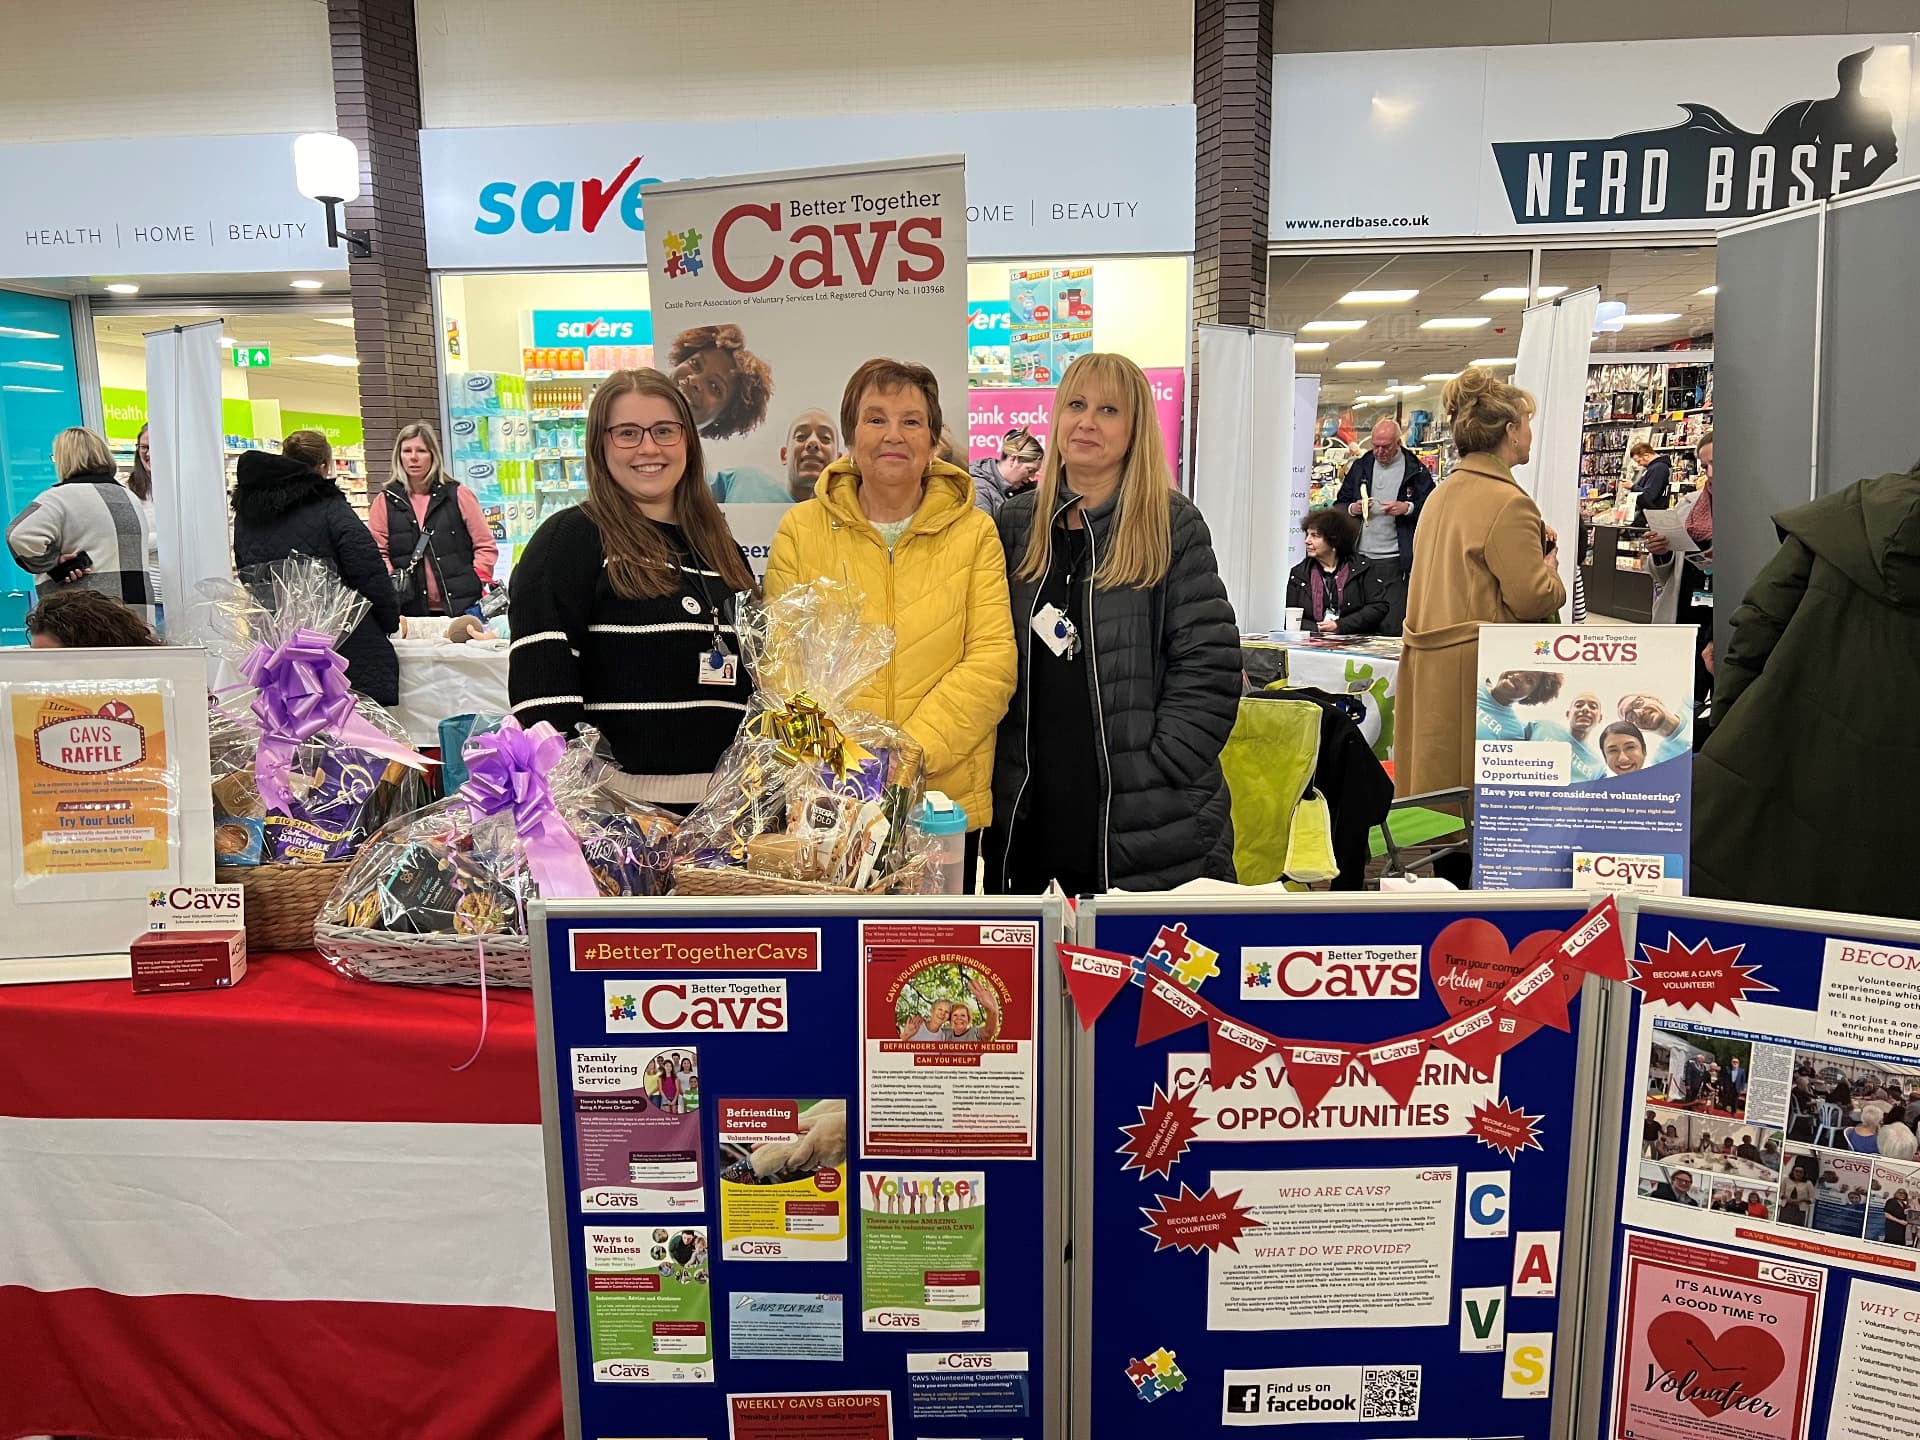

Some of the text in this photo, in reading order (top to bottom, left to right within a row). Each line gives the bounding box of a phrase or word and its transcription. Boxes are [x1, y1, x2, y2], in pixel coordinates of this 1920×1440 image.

[1525, 142, 1853, 218] NERD BASE
[474, 155, 668, 235] save
[789, 190, 942, 218] Better Together
[966, 202, 1139, 222] OME BEAUTY
[1285, 214, 1430, 231] www.nerdbase.co.uk
[25, 223, 307, 246] HEALTH HOME BEAUTY
[711, 202, 945, 294] Cavs
[703, 296, 742, 307] Association
[743, 295, 751, 305] of
[751, 293, 785, 307] Voluntary
[785, 293, 815, 303] Services
[830, 289, 867, 301] Registered
[868, 288, 895, 300] Charity
[897, 286, 912, 296] No.
[912, 285, 945, 295] 1103968
[556, 317, 633, 339] savers
[104, 403, 143, 420] Health
[968, 404, 1048, 427] pink sack
[1605, 634, 1637, 643] Together
[1553, 634, 1637, 662] Cavs
[70, 726, 112, 744] CAVS
[61, 745, 122, 764] RAFFLE
[1482, 744, 1513, 753] CAVS
[1482, 757, 1554, 769] Volunteering
[1482, 770, 1559, 782] Opportunities
[1480, 787, 1681, 804] Have you ever considered volunteering?
[59, 814, 135, 828] Try Your Luck!
[279, 833, 308, 847] DAIRY
[307, 840, 330, 852] MILK
[1594, 856, 1661, 880] Cavs
[169, 887, 241, 910] Cavs
[991, 928, 1032, 943] Cavs
[1571, 917, 1608, 949] Cavs
[584, 943, 808, 964] #BetterTogetherCavs
[1327, 950, 1417, 962] Better Together
[1445, 954, 1491, 971] Turn your
[1840, 947, 1920, 972] BECOM
[1082, 958, 1120, 977] Cavs
[1277, 951, 1418, 998] Cavs
[1652, 969, 1723, 979] BECOME A CAVS
[885, 953, 1013, 1004] CAVS VOLUNTEER BEFRIENDING SERVICE
[1438, 966, 1505, 993] Action and
[1662, 981, 1715, 990] VOLUNTEER!
[691, 983, 782, 996] Better Together
[1831, 982, 1892, 997] experiences
[641, 984, 784, 1030] Cavs
[1828, 991, 1848, 1000] well
[1865, 995, 1901, 1009] helping
[1453, 1014, 1491, 1039] Cavs
[1830, 1010, 1847, 1019] It's
[1849, 1013, 1866, 1022] not
[1868, 1015, 1888, 1025] just
[1827, 1028, 1919, 1051] healthy and happy
[1842, 1022, 1913, 1039] enriches their
[883, 1042, 936, 1050] BEFRIENDERS
[980, 1043, 1015, 1051] NEEDED!
[1664, 1020, 1689, 1031] FOCUS
[1693, 1025, 1712, 1033] CAVS
[1713, 1028, 1730, 1036] puts
[1731, 1029, 1749, 1039] icing
[1793, 1039, 1827, 1051] following
[1829, 1046, 1860, 1056] national
[1861, 1051, 1900, 1062] volunteers
[576, 1053, 618, 1064] Family
[1302, 1051, 1339, 1064] Cavs
[1380, 1043, 1418, 1062] Cavs
[577, 1064, 638, 1075] Mentoring
[578, 1076, 621, 1085] Service
[726, 1108, 791, 1120] Befriending
[1216, 1103, 1450, 1130] OPPORTUNITIES
[726, 1119, 768, 1128] Service
[1832, 1158, 1871, 1175] Cavs
[1422, 1171, 1452, 1181] Cavs
[866, 1174, 980, 1198] Volunteer
[1279, 1185, 1391, 1198] WHO ARE CAVS?
[596, 1192, 639, 1206] Cavs
[1469, 1184, 1506, 1226] C
[1166, 1215, 1199, 1225] BECOME
[1205, 1212, 1227, 1221] CAVS
[1175, 1224, 1220, 1234] VOLUNTEER!
[592, 1234, 634, 1244] Ways to
[592, 1245, 641, 1254] Wellness
[1254, 1243, 1411, 1258] WHAT DO WE PROVIDE?
[1517, 1244, 1552, 1284] A
[1771, 1267, 1818, 1288] Cavs
[1675, 1279, 1763, 1305] IT'S ALWAYS
[750, 1303, 824, 1313] CAVS PEN PALS
[1661, 1293, 1778, 1325] A GOOD TIME TO
[1860, 1300, 1900, 1318] WHY
[877, 1313, 920, 1327] Cavs
[1465, 1299, 1501, 1340] V
[1865, 1319, 1908, 1335] Volunteering
[947, 1353, 992, 1368] Cavs
[1510, 1345, 1544, 1386] S
[1266, 1384, 1331, 1394] Find us on
[1644, 1363, 1781, 1419] Volunteer
[736, 1397, 881, 1409] WEEKLY CAVS GROUPS
[1266, 1394, 1357, 1413] facebook
